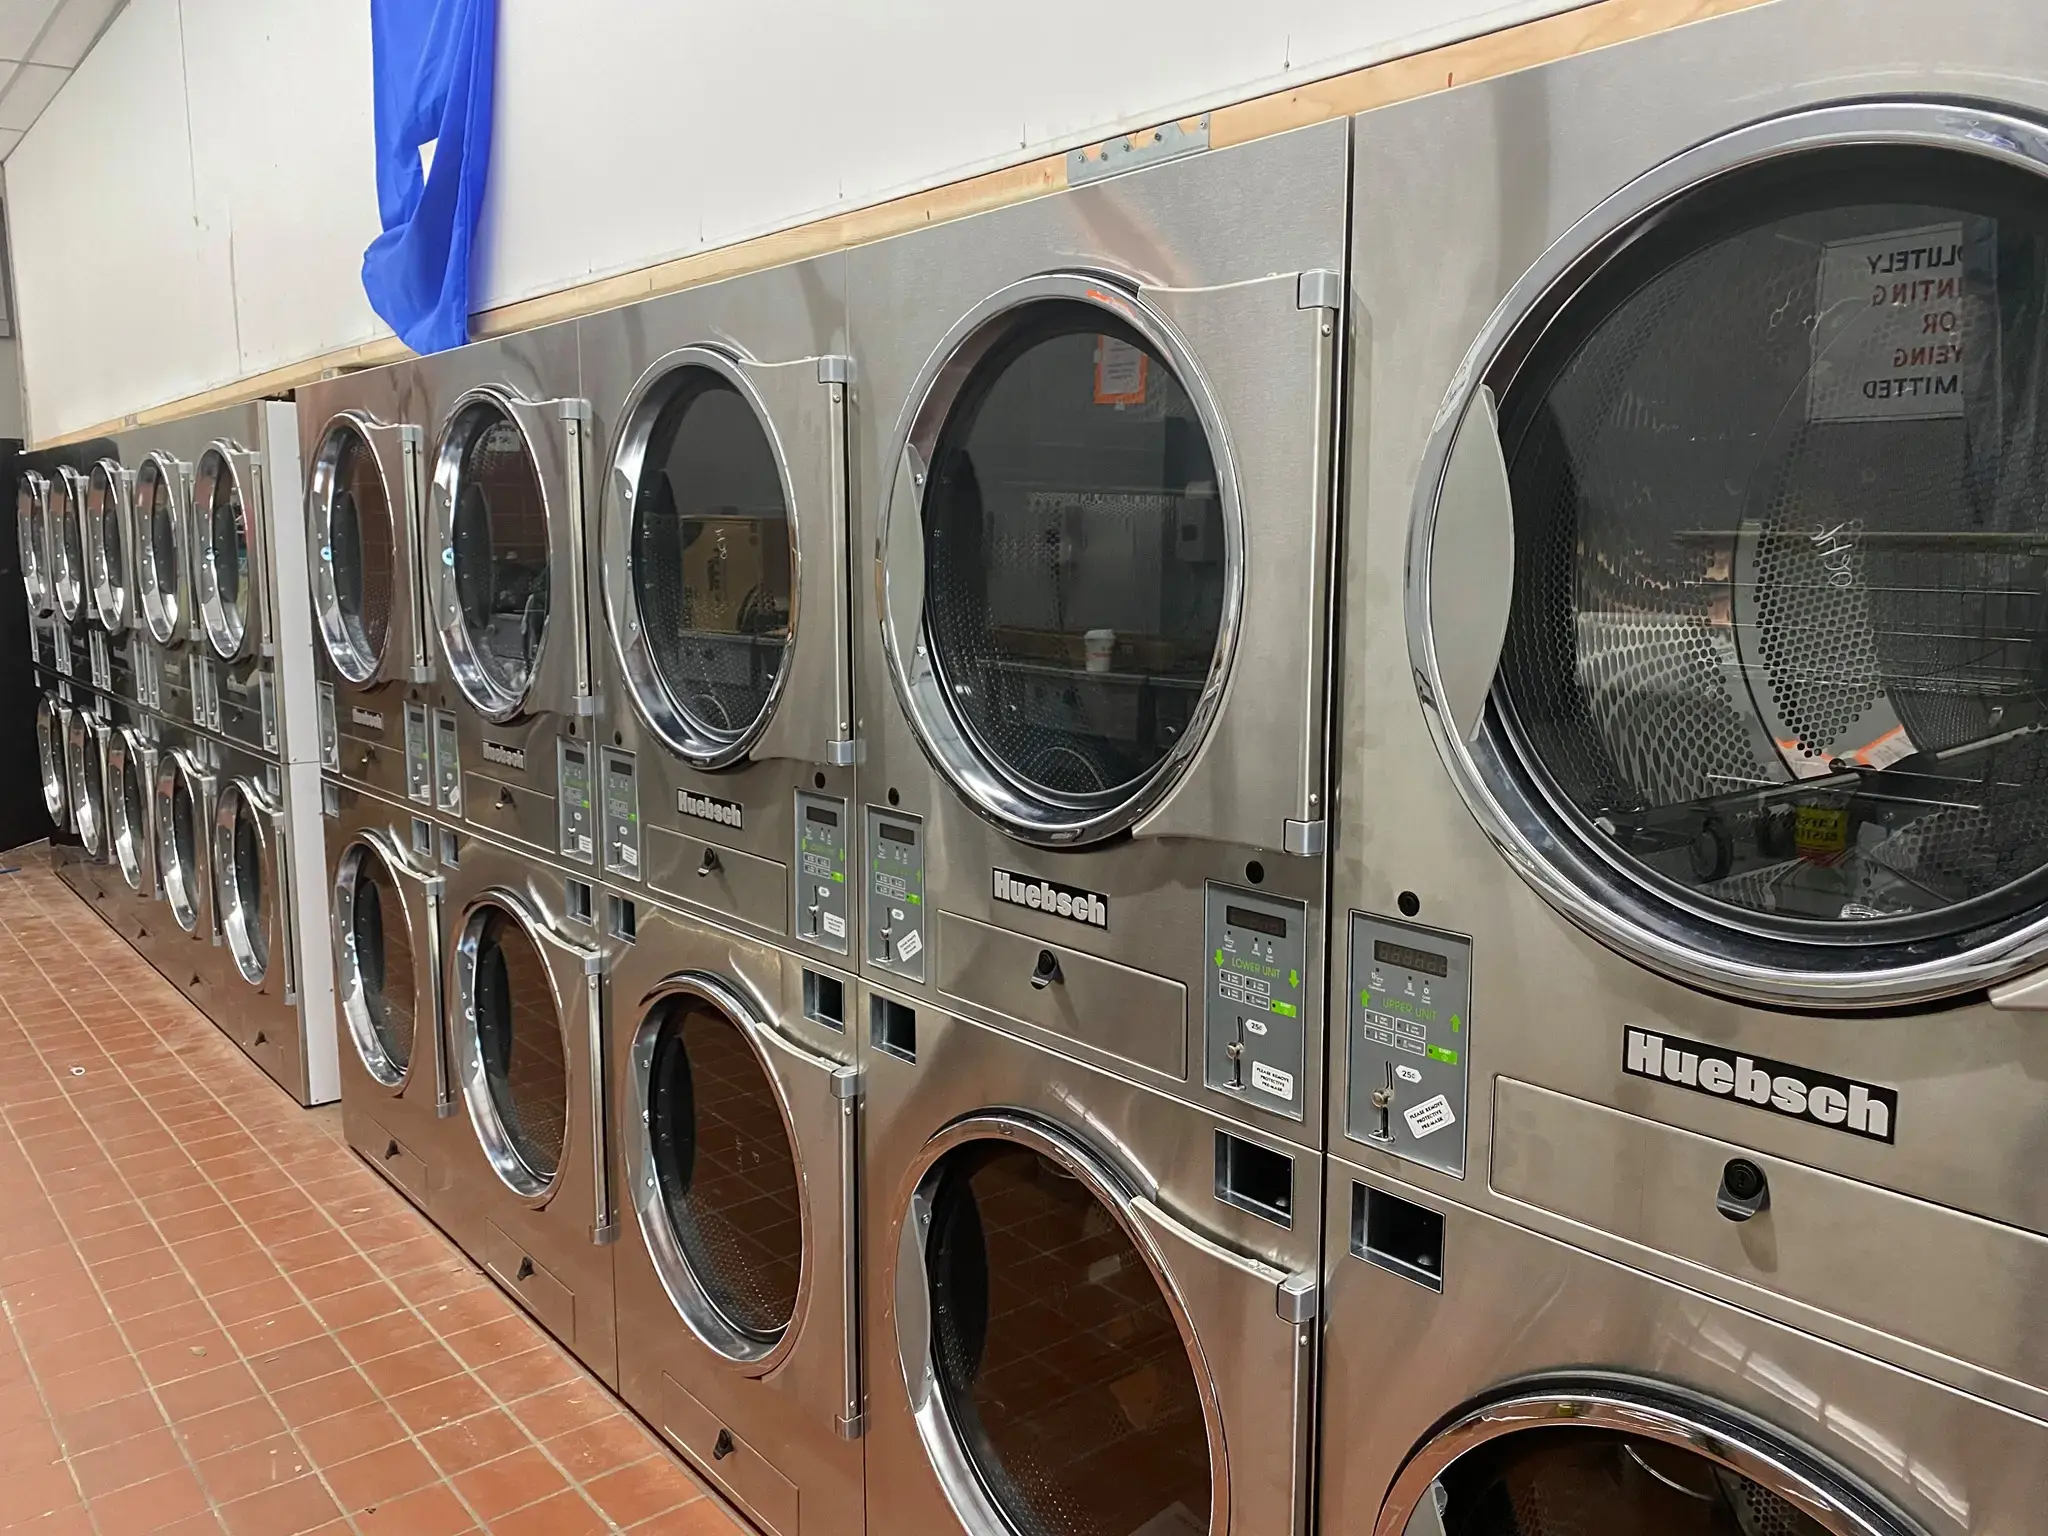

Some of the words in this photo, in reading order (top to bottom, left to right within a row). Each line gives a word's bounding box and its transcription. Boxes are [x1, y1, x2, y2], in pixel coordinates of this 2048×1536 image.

[677, 790, 741, 828] Huebsch
[993, 869, 1106, 926] Huebsch
[1231, 957, 1260, 973] LOWER
[1262, 965, 1281, 979] UNIT
[1382, 998, 1413, 1014] UPPER
[1415, 1007, 1437, 1021] UNIT
[1627, 1030, 1889, 1137] Huebsch
